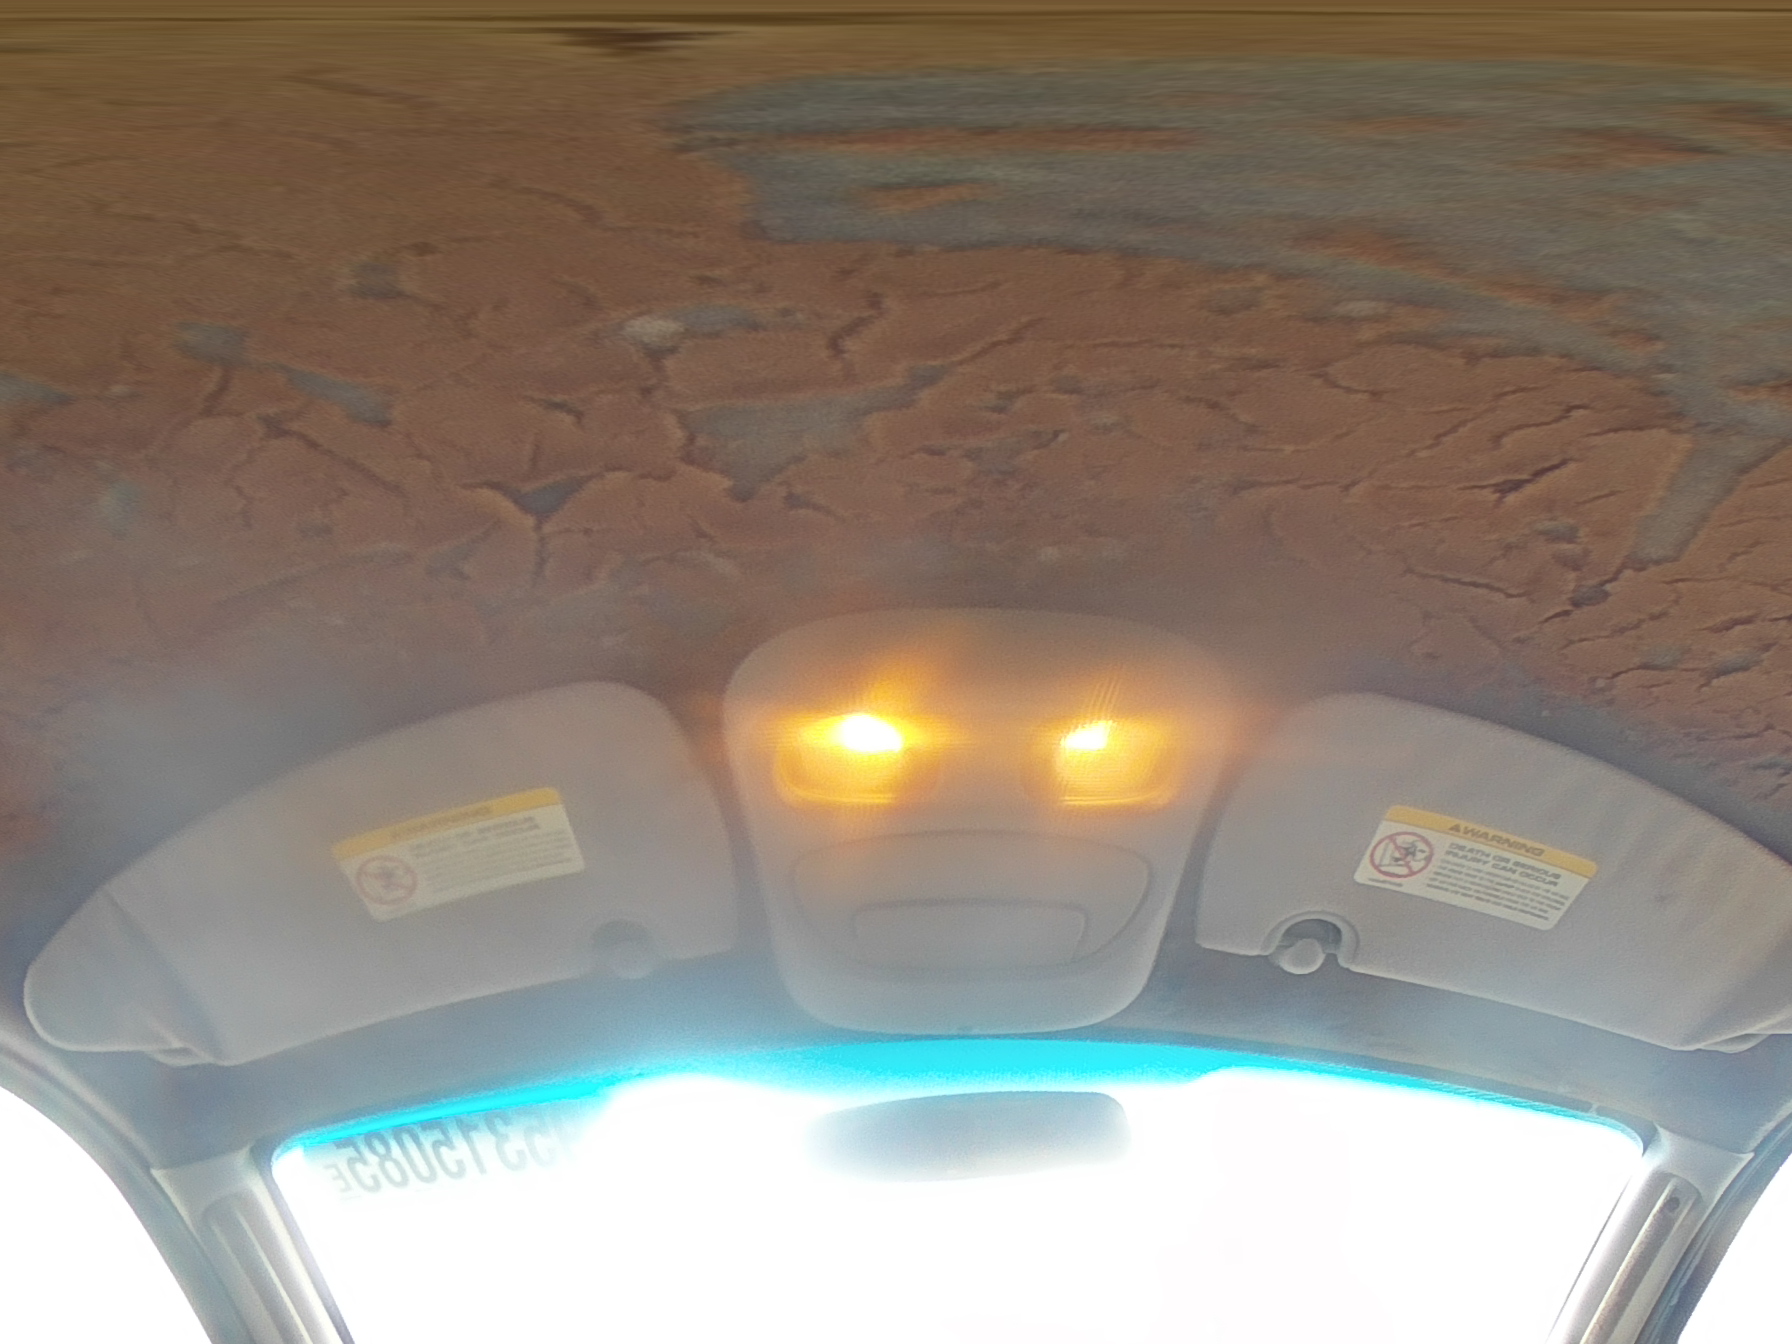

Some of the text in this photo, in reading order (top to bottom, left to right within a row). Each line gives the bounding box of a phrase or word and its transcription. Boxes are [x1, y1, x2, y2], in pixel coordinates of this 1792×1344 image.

[1463, 825, 1546, 857] WARNING
[1444, 850, 1559, 888] INJURY CAN OCCUR
[1448, 842, 1562, 880] DEATH OR SERIOUS
